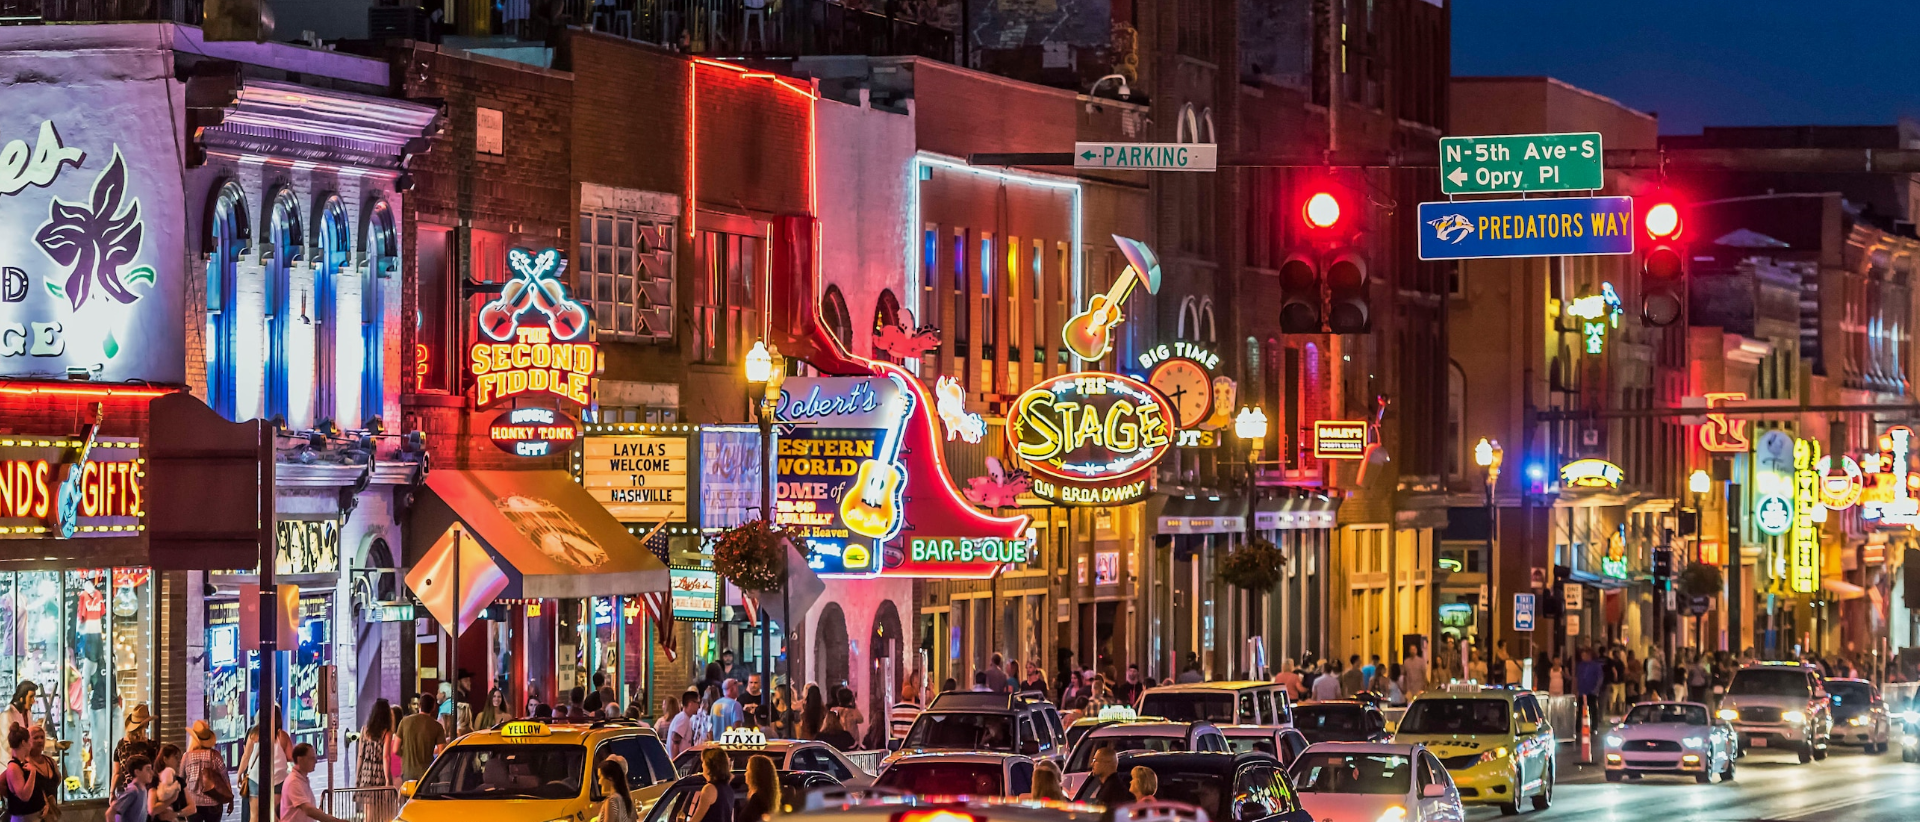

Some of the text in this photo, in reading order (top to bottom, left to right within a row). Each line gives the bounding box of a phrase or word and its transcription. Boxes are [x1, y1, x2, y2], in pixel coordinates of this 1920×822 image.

[1103, 146, 1188, 167] PARKING
[1446, 140, 1595, 163] N-5th Ave-S
[1475, 165, 1560, 189] Opry Pl
[1478, 211, 1631, 240] PREDATORS WAY
[516, 327, 550, 344] THE
[471, 343, 595, 376] SECOND
[1138, 341, 1220, 370] BIG TIME
[476, 368, 589, 406] FIDDLE
[1074, 376, 1107, 395] THE
[763, 380, 880, 429] Robert's
[491, 426, 575, 440] HONKY TONK
[1017, 388, 1169, 461] STAGE
[515, 441, 549, 456] CITY
[613, 443, 666, 456] LAYLA'S
[777, 438, 875, 457] ESTERN
[610, 458, 670, 472] WELCOME
[81, 460, 141, 518] GIFTS
[631, 474, 646, 487] TO
[1034, 478, 1145, 502] ON BROADWAY
[611, 489, 673, 502] NASHVILLE
[777, 481, 828, 500] OME
[830, 481, 847, 504] of
[811, 526, 849, 538] Heaven
[911, 538, 1027, 563] BAR-B-QUE
[508, 724, 541, 735] YELLOW
[722, 734, 760, 744] TAXI
